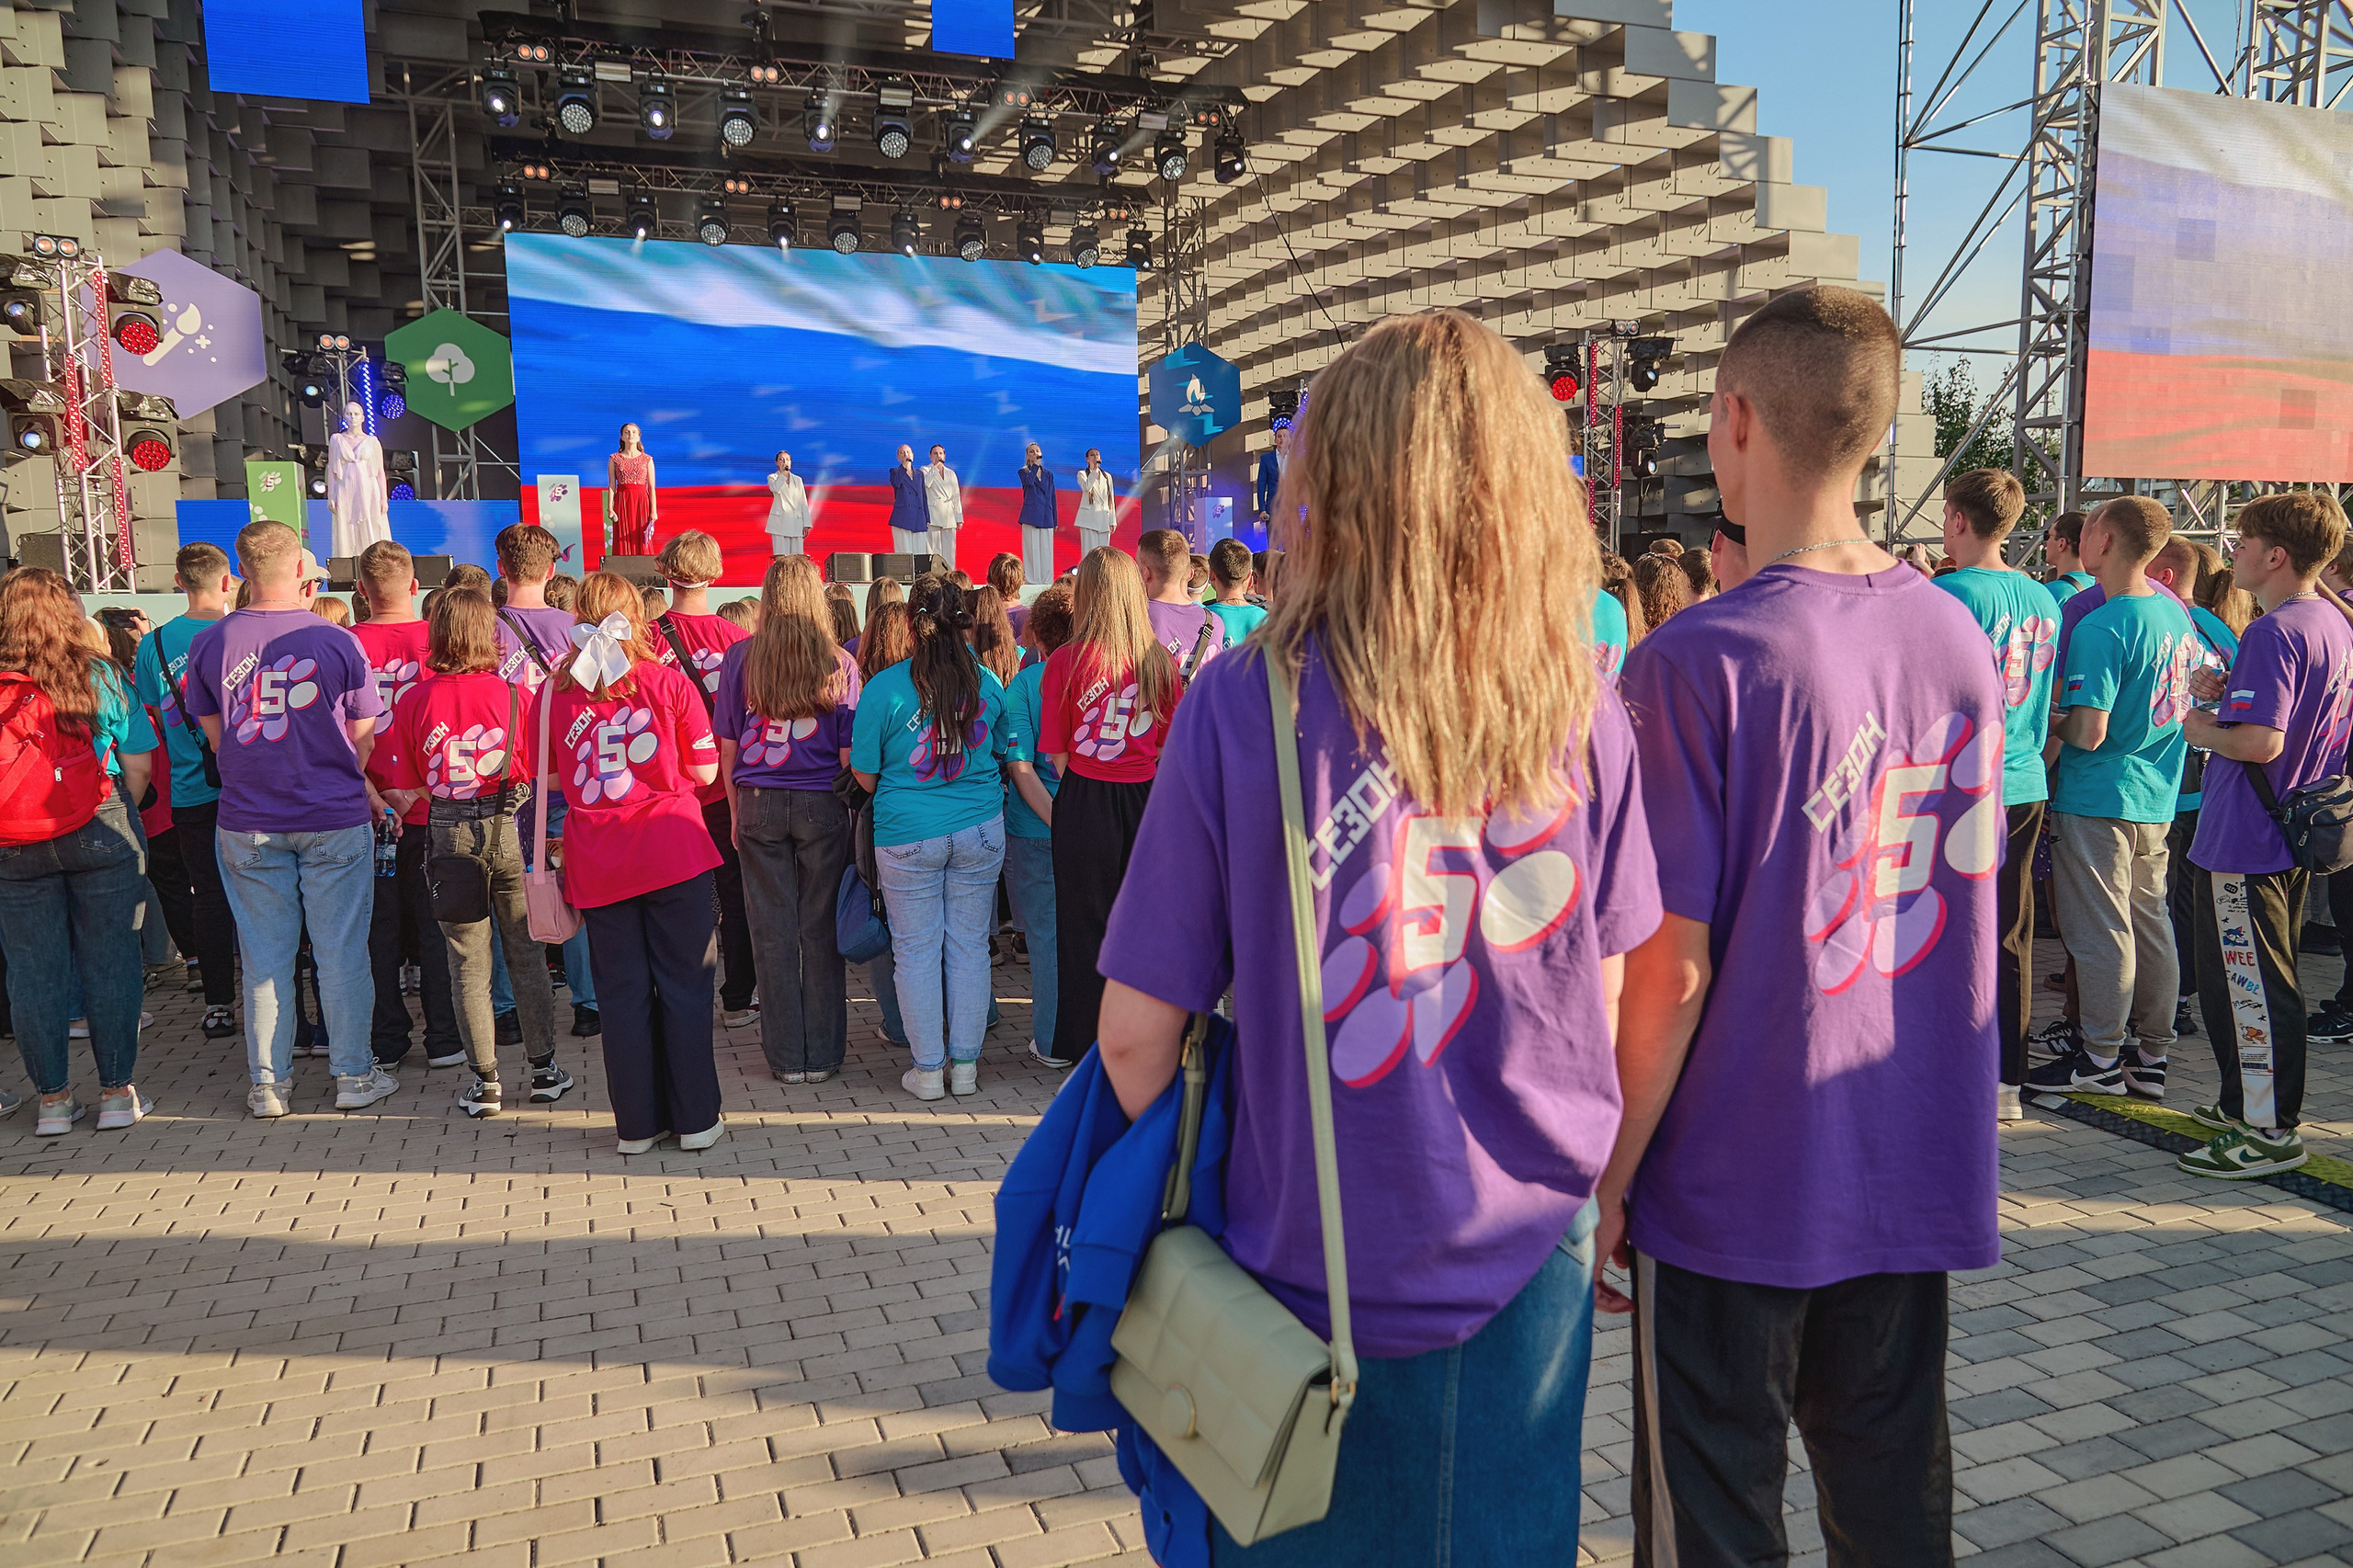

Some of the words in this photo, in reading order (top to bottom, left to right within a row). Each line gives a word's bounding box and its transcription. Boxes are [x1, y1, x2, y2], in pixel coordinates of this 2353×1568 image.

[1987, 611, 2013, 643] ЕЗОН
[222, 652, 259, 691] СЕЗОН
[498, 645, 529, 680] СЕЗОН
[2009, 631, 2034, 677] 5
[259, 671, 288, 715] 5
[1076, 676, 1110, 712] СЕЗОН
[422, 721, 450, 756] СЕЗОН
[563, 706, 597, 750] СЕЗОН
[1099, 698, 1133, 741] 5
[449, 741, 477, 781] 5
[597, 725, 628, 773] 5
[1801, 710, 1888, 834] СЕЗОН
[1874, 763, 1949, 899] 5
[1402, 813, 1483, 971] 5
[2224, 949, 2256, 966] WEE
